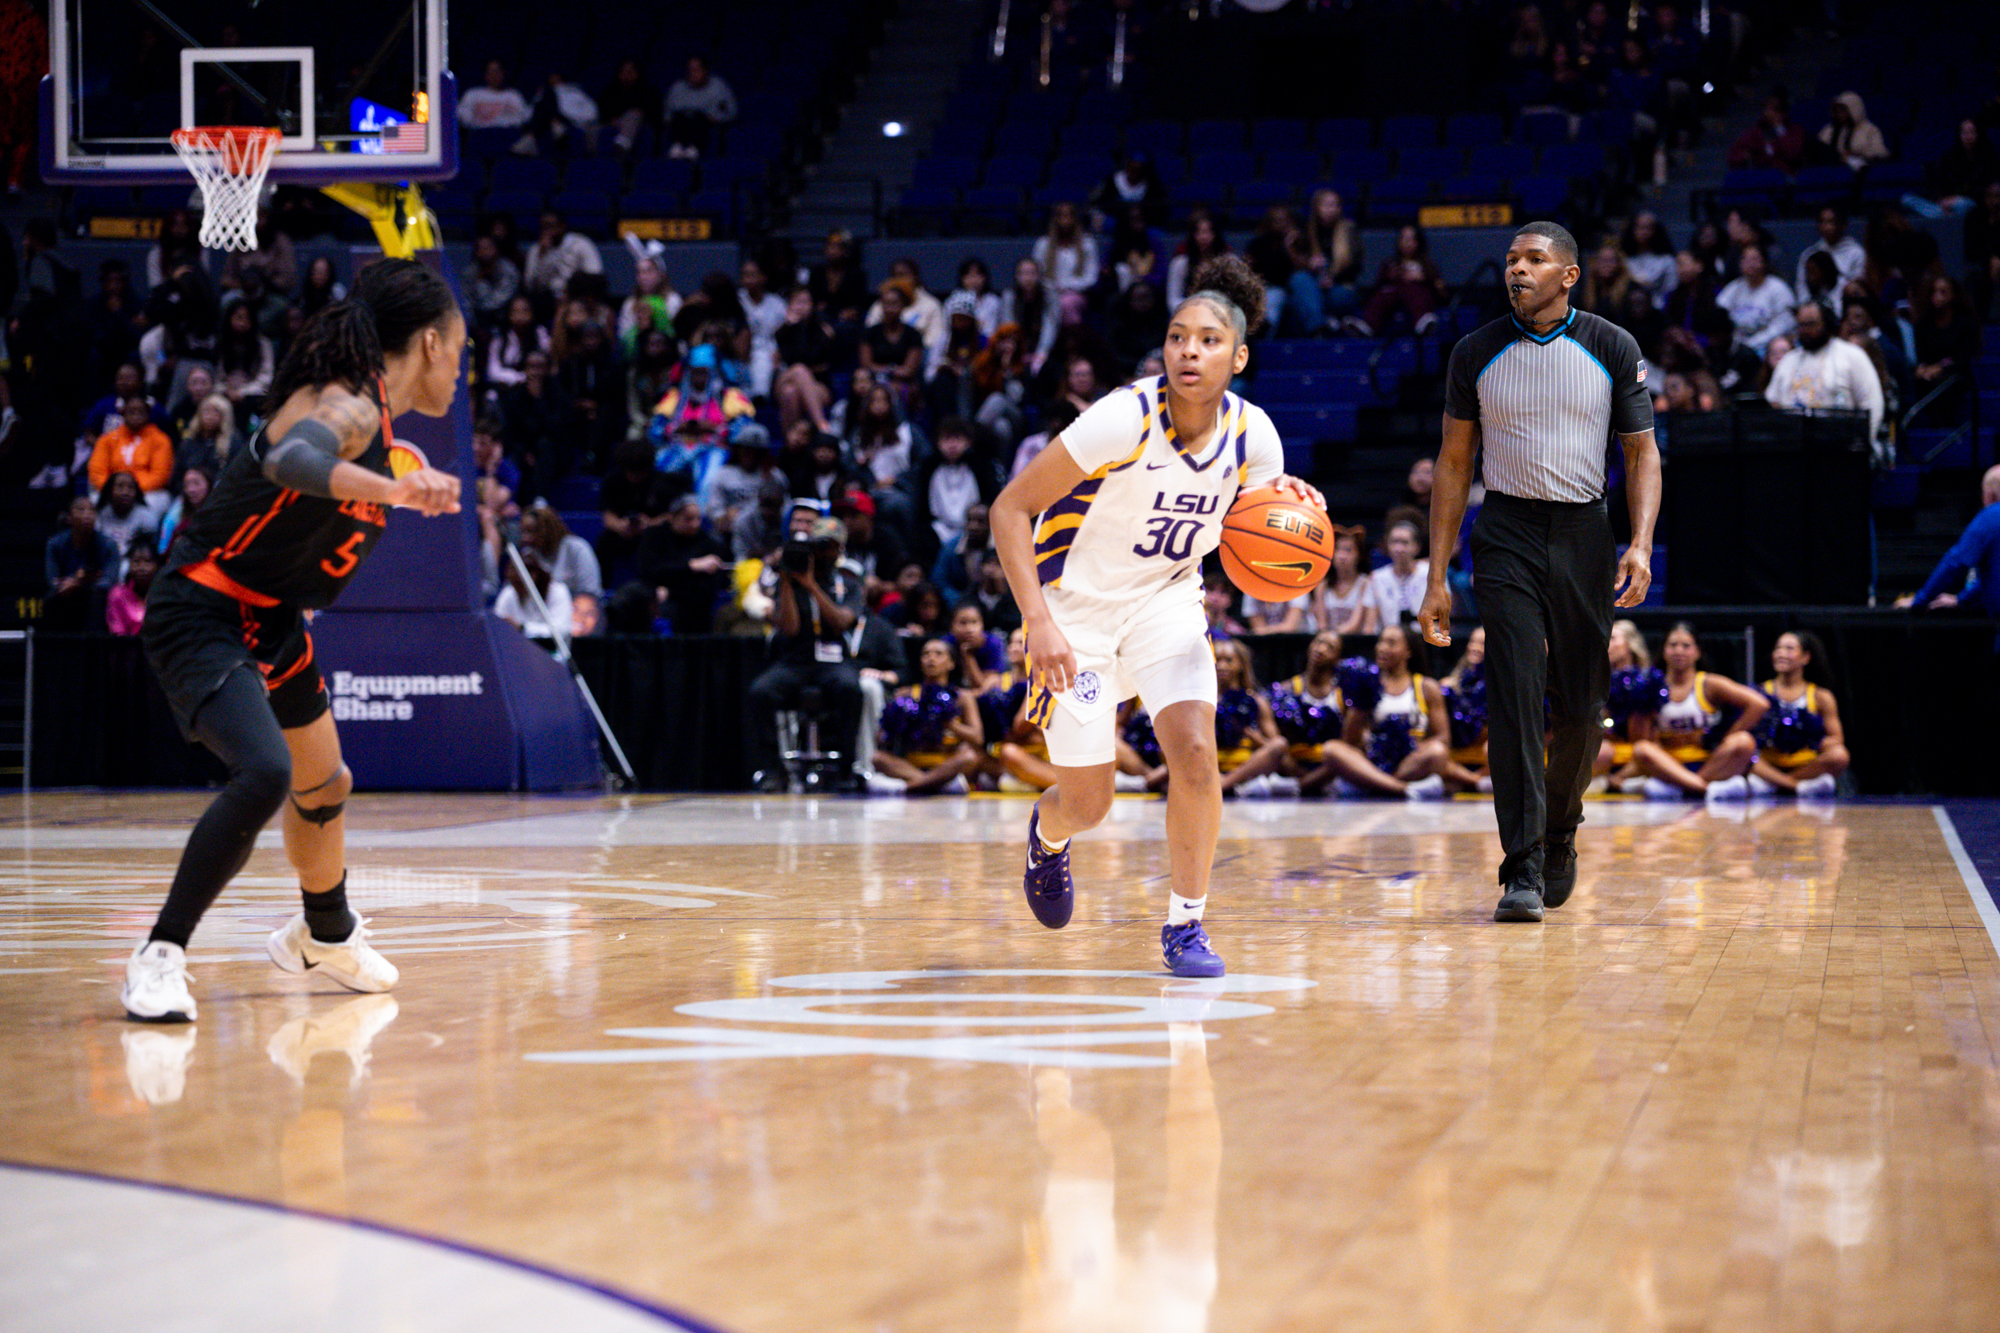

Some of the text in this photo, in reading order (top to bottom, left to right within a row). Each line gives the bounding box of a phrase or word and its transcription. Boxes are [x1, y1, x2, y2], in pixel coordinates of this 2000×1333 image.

[1152, 491, 1220, 514] LSU
[1133, 517, 1206, 561] 30
[1266, 513, 1324, 546] ELITE
[320, 531, 366, 578] 5
[332, 697, 414, 721] Share
